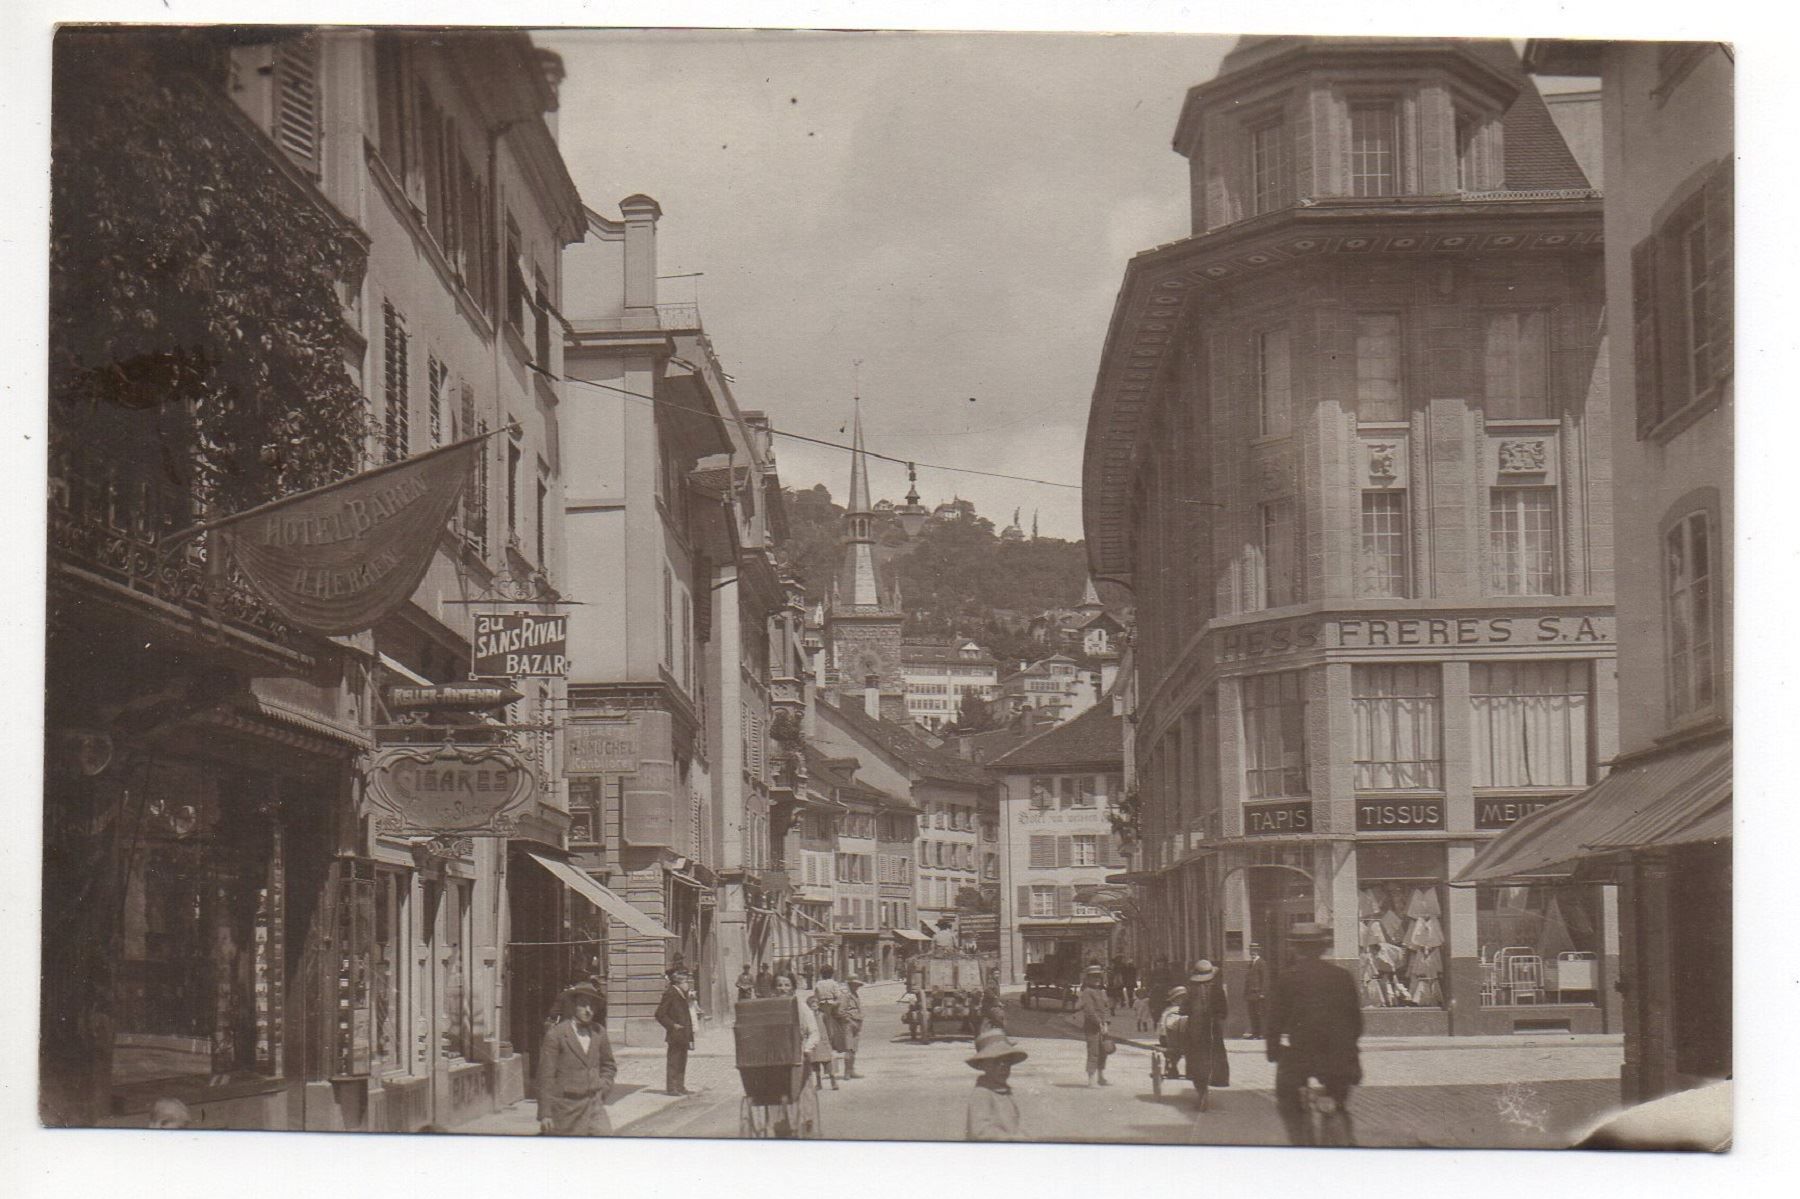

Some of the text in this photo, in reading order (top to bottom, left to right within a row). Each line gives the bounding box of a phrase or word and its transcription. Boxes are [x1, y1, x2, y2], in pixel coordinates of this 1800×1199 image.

[264, 514, 353, 546] HOTEL
[476, 618, 565, 658] SANS RIVAL
[477, 617, 504, 633] au
[1223, 615, 1608, 659] HESS FRERES S.A.
[506, 654, 566, 674] BAZAR
[1250, 808, 1307, 831] TAPIS
[1361, 805, 1440, 825] TISSUS
